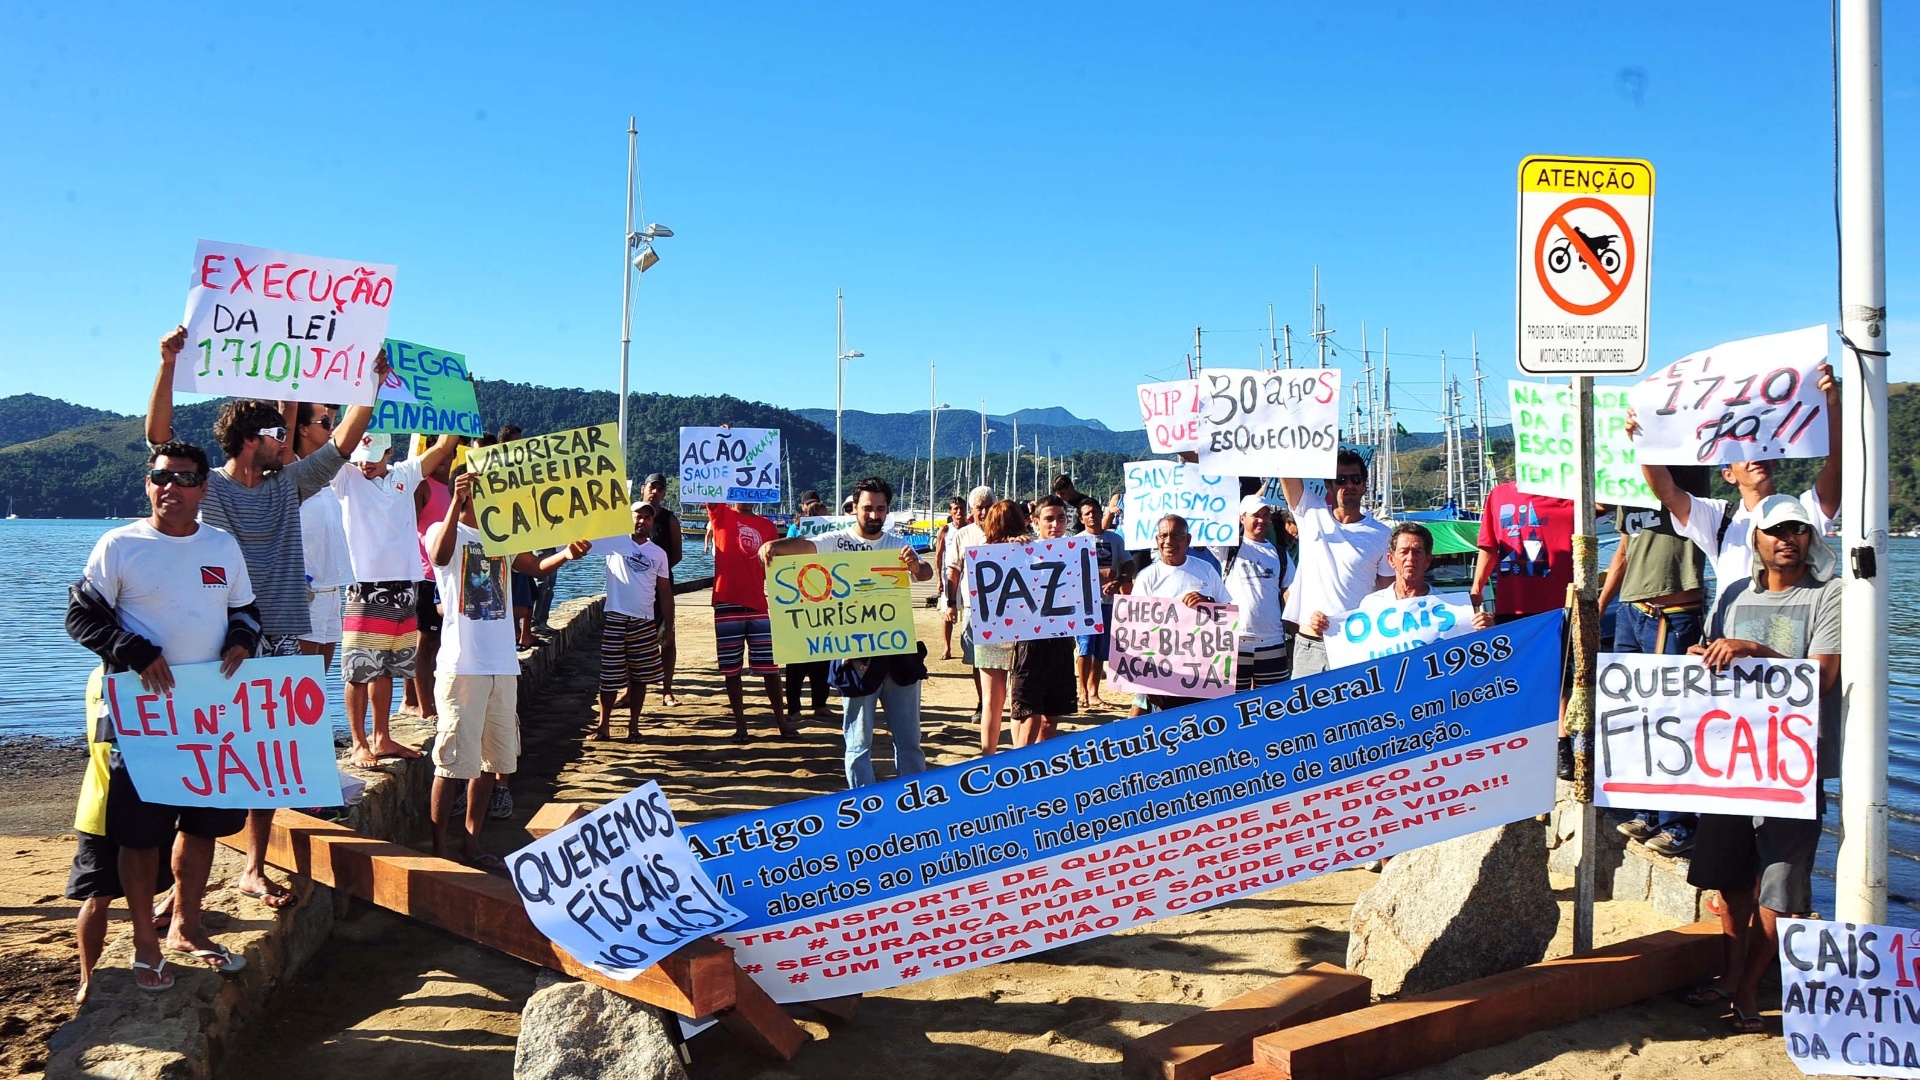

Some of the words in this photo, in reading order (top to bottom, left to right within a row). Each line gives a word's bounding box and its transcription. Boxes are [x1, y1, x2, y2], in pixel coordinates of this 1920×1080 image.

[1537, 168, 1635, 192] ATENÇÃO
[201, 254, 393, 313] EXECUÇÃO
[214, 304, 259, 333] DA
[1527, 325, 1555, 339] PROIBIDO
[1586, 325, 1594, 339] DE
[303, 343, 365, 387] JÁ!
[387, 343, 468, 381] EGA
[1540, 348, 1573, 362] MOTONETAS
[1575, 348, 1579, 362] E
[1205, 374, 1258, 426] 30
[1514, 386, 1543, 407] NA
[1656, 367, 1800, 415] 1.710
[1210, 424, 1335, 455] ESQUECIDOS
[1520, 410, 1548, 430] DA
[1562, 413, 1625, 439] FIP
[682, 433, 747, 465] AÇÃO
[472, 480, 485, 501] A
[487, 455, 616, 494] BALEEIRA
[684, 465, 729, 481] SAÚDE
[736, 462, 779, 488] JÁ!
[1129, 465, 1184, 490] SALVE
[480, 479, 628, 543] CAIÇARA
[801, 520, 857, 535] JUVENT
[975, 547, 1095, 627] PAZ!
[1114, 598, 1179, 624] CHEGA
[1195, 605, 1228, 626] DE
[1345, 611, 1371, 643] O
[806, 630, 908, 656] NÁUTICO
[1113, 651, 1173, 683] AÇÃO
[1180, 654, 1232, 689] JÁ!
[1599, 662, 1815, 707] QUEREMOS
[232, 676, 325, 733] 1710
[176, 731, 307, 798] JÁ!!!
[690, 815, 824, 862] Artigo
[897, 780, 949, 814] da
[958, 714, 1227, 798] Constituição
[1235, 666, 1384, 730] Federal
[1395, 657, 1411, 692] /
[1425, 635, 1514, 681] 1988
[758, 854, 840, 888] todos
[847, 827, 940, 872] podem
[948, 797, 1067, 843] reunir-se
[1073, 747, 1260, 815] pacificamente,
[1264, 731, 1318, 759] sem
[1323, 709, 1405, 746] armas,
[1410, 698, 1445, 722] em
[1451, 676, 1519, 711] locais
[767, 878, 872, 917] abertos
[878, 868, 912, 890] ao
[919, 841, 1028, 886] público,
[1034, 766, 1286, 852] independentemente
[1291, 760, 1323, 784] de
[1329, 720, 1470, 773] autorização.
[514, 791, 675, 905] QUEREMOS
[736, 880, 990, 946] TRANSPORTE
[1002, 865, 1049, 887] DE
[1060, 810, 1261, 871] QUALIDADE
[1271, 801, 1291, 816] E
[1303, 768, 1411, 807] PREÇO
[1421, 737, 1529, 773] JUSTO
[776, 911, 1010, 971] SEGURANÇA
[1197, 815, 1360, 869] RESPEITO
[1372, 805, 1394, 821] À
[1402, 774, 1509, 810] VIDA!!!
[807, 937, 828, 950] #
[841, 921, 899, 942] UM
[912, 877, 1074, 926] SISTEMA
[1085, 808, 1331, 882] EDUCACIONAL
[1341, 775, 1446, 812] DIGNO
[788, 972, 810, 984] #
[822, 958, 880, 978] UM
[893, 904, 1101, 964] PROGRAMA
[1111, 888, 1157, 909] DE
[1168, 852, 1283, 893] SAÚDE
[594, 943, 649, 969] NO
[899, 965, 921, 979] #
[1044, 916, 1120, 944] NÃO
[1132, 906, 1155, 921] À
[1790, 1032, 1830, 1060] DA
